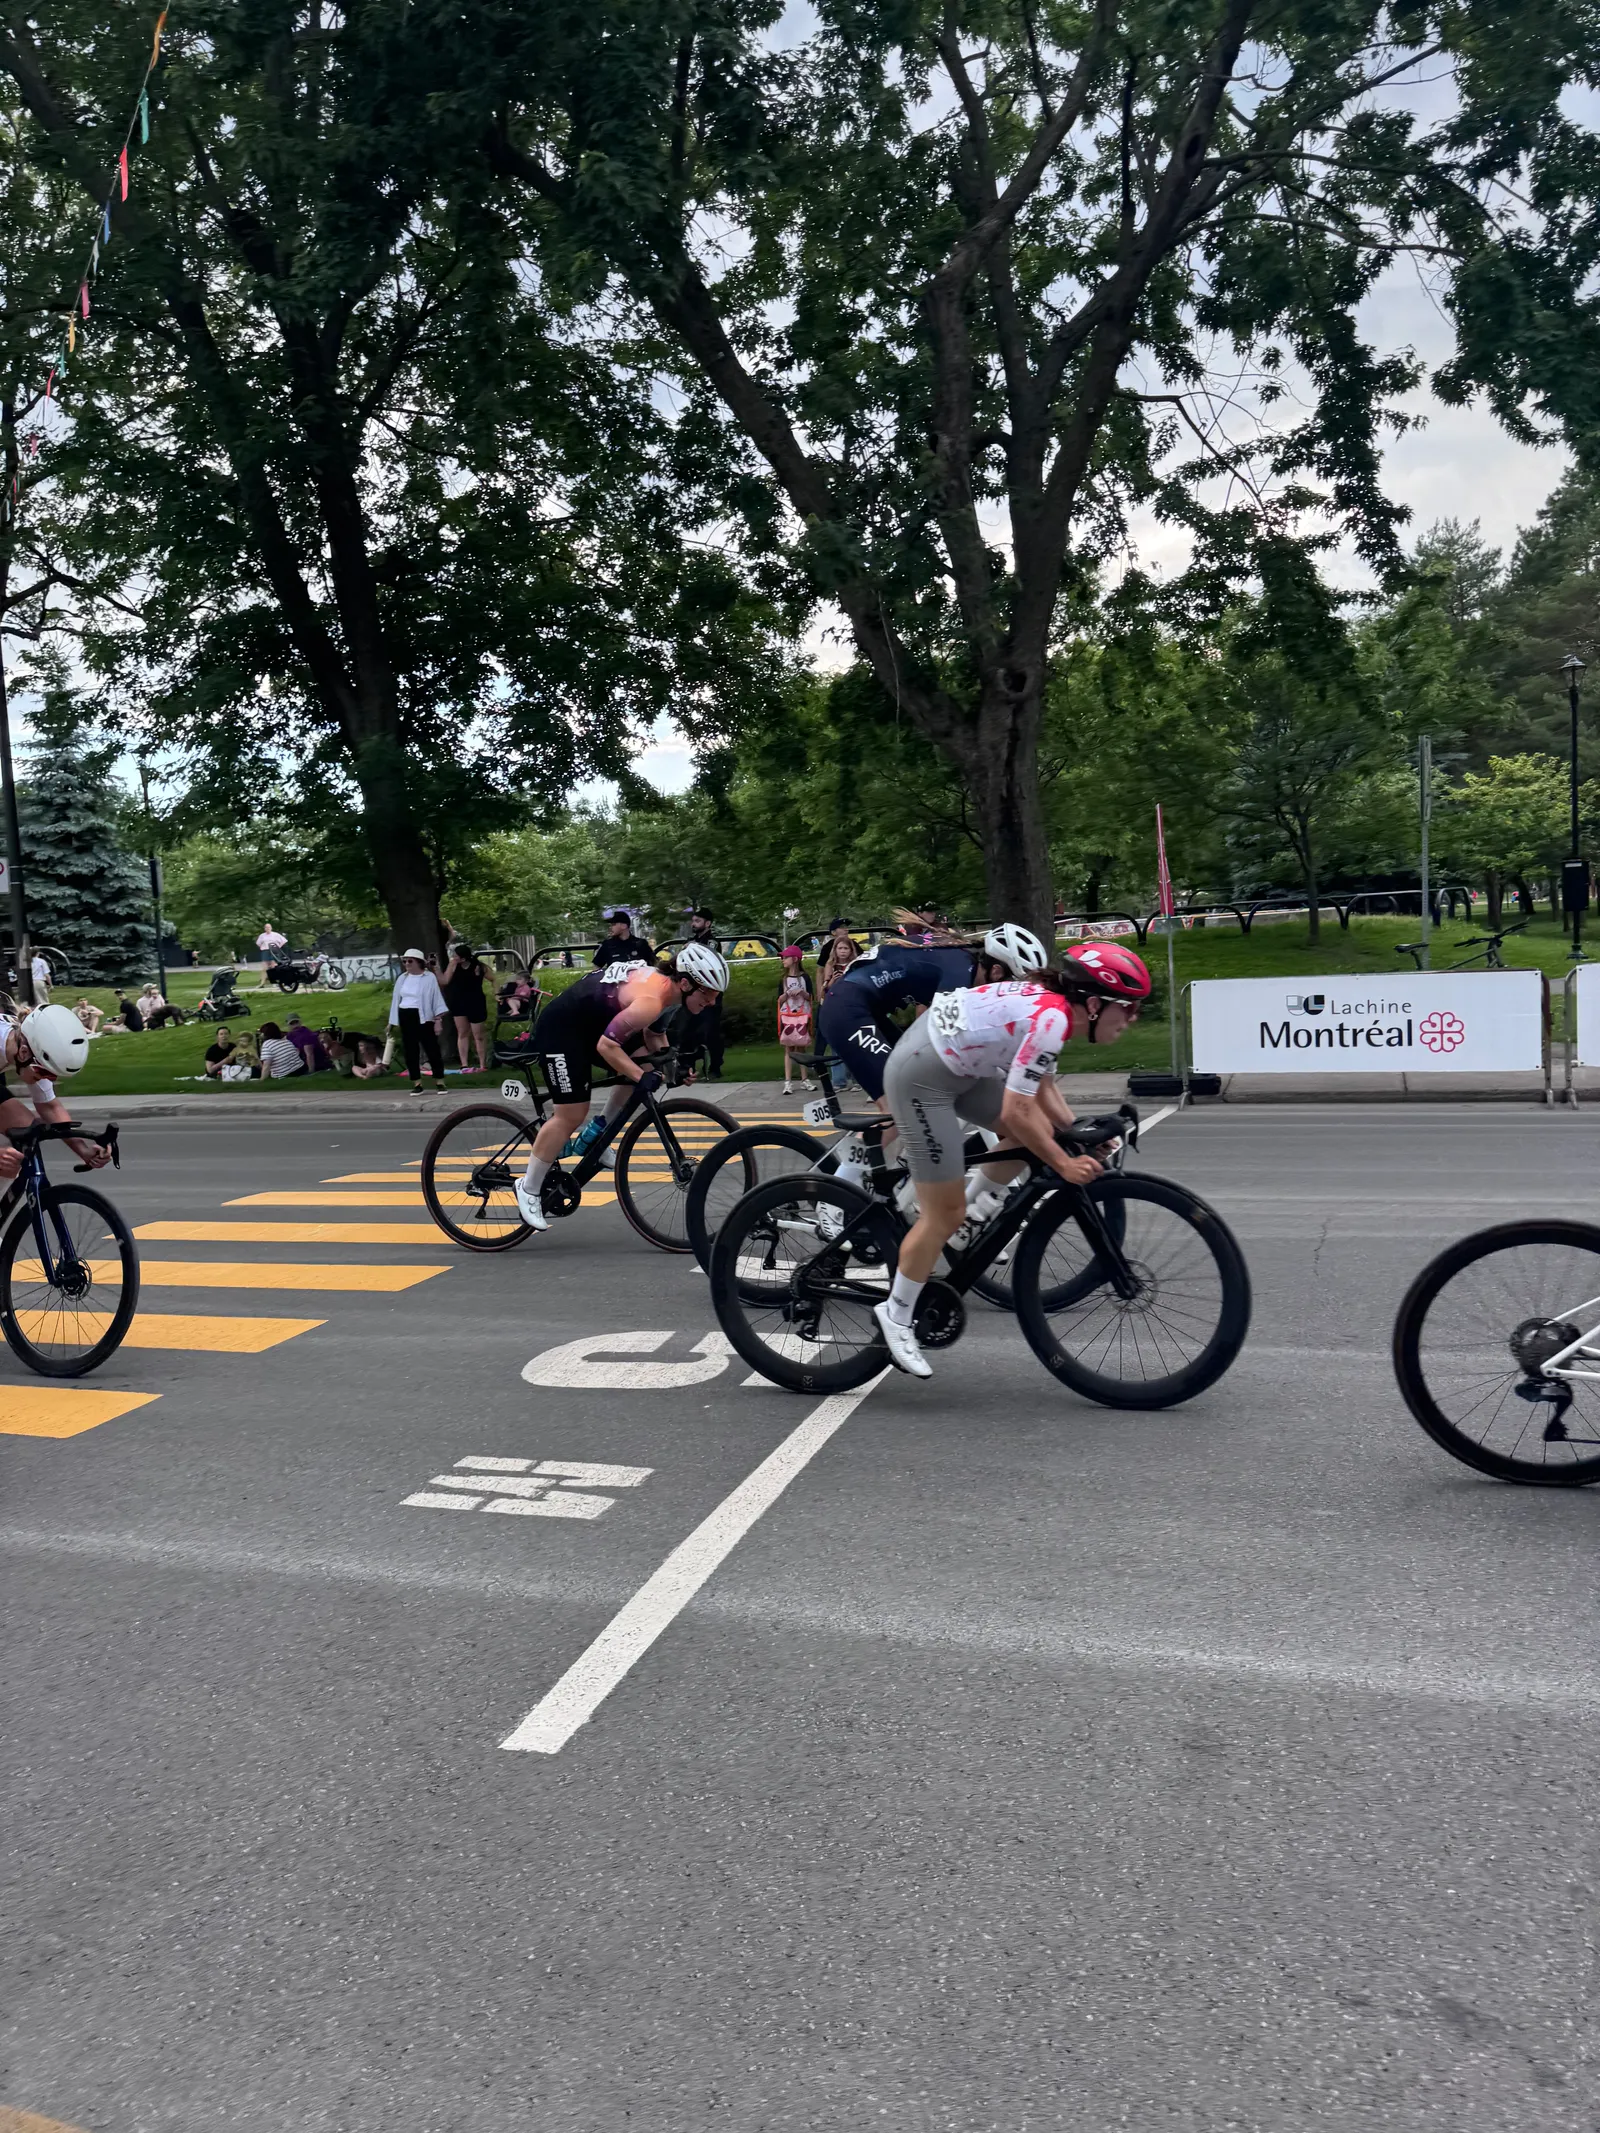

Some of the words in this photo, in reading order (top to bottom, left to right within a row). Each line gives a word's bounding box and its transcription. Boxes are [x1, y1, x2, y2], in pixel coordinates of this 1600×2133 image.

[1331, 999, 1412, 1015] Lachine
[1260, 1019, 1413, 1049] Montréal
[504, 1085, 520, 1097] 379
[812, 1105, 831, 1122] 305
